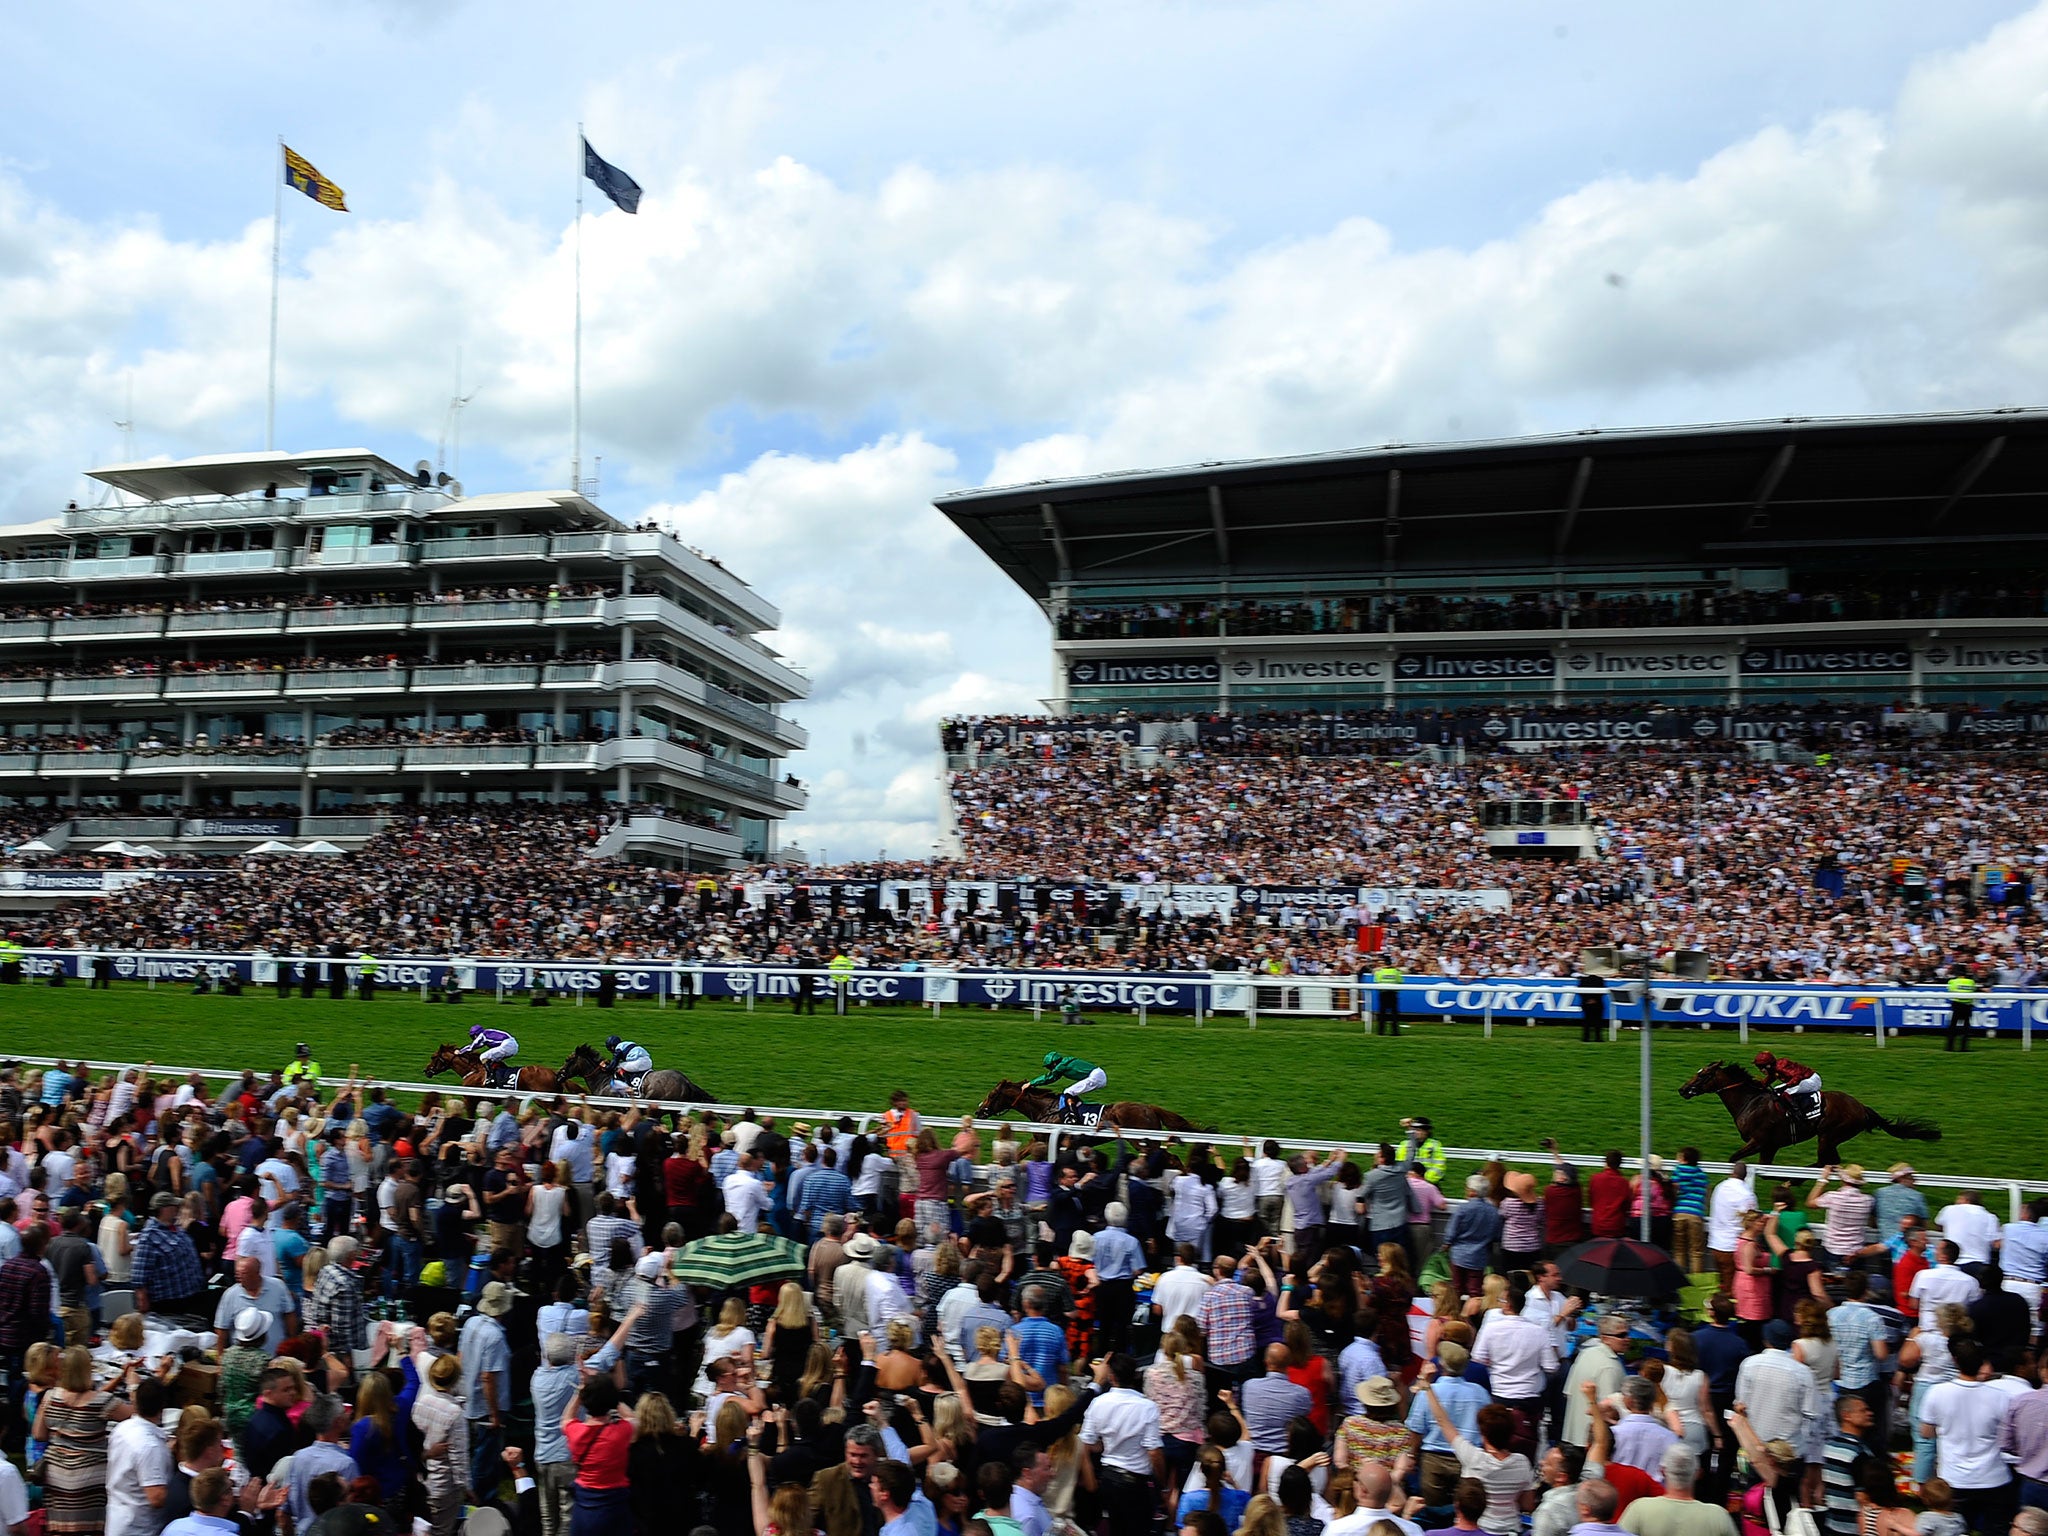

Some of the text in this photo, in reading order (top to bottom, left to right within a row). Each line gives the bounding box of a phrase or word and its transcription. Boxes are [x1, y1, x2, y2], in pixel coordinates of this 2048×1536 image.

[1259, 658, 1380, 679] Investec
[1425, 655, 1553, 676] Investec
[1596, 652, 1726, 673] Investec
[1774, 649, 1910, 670] Investec
[1099, 662, 1218, 682] Investec
[1333, 723, 1417, 742] Banking
[1509, 717, 1653, 739] Investec
[1721, 716, 1871, 739] Invesc
[1958, 715, 2026, 732] Asset
[1009, 726, 1135, 745] Inestec
[216, 822, 280, 834] Investec
[1019, 885, 1109, 901] Inesec
[1260, 889, 1357, 905] Investec
[1388, 891, 1483, 907] Inetec
[137, 957, 236, 979] Investec
[319, 962, 431, 984] Ivstec
[524, 967, 650, 990] Invesec
[1019, 979, 1179, 1005] Investec
[1425, 983, 1583, 1012] CORAL
[1681, 994, 1853, 1020] CORAL
[1902, 1009, 1999, 1027] BETTNG
[507, 1073, 516, 1084] 2
[631, 1077, 641, 1087] 8
[1082, 1112, 1098, 1126] 13
